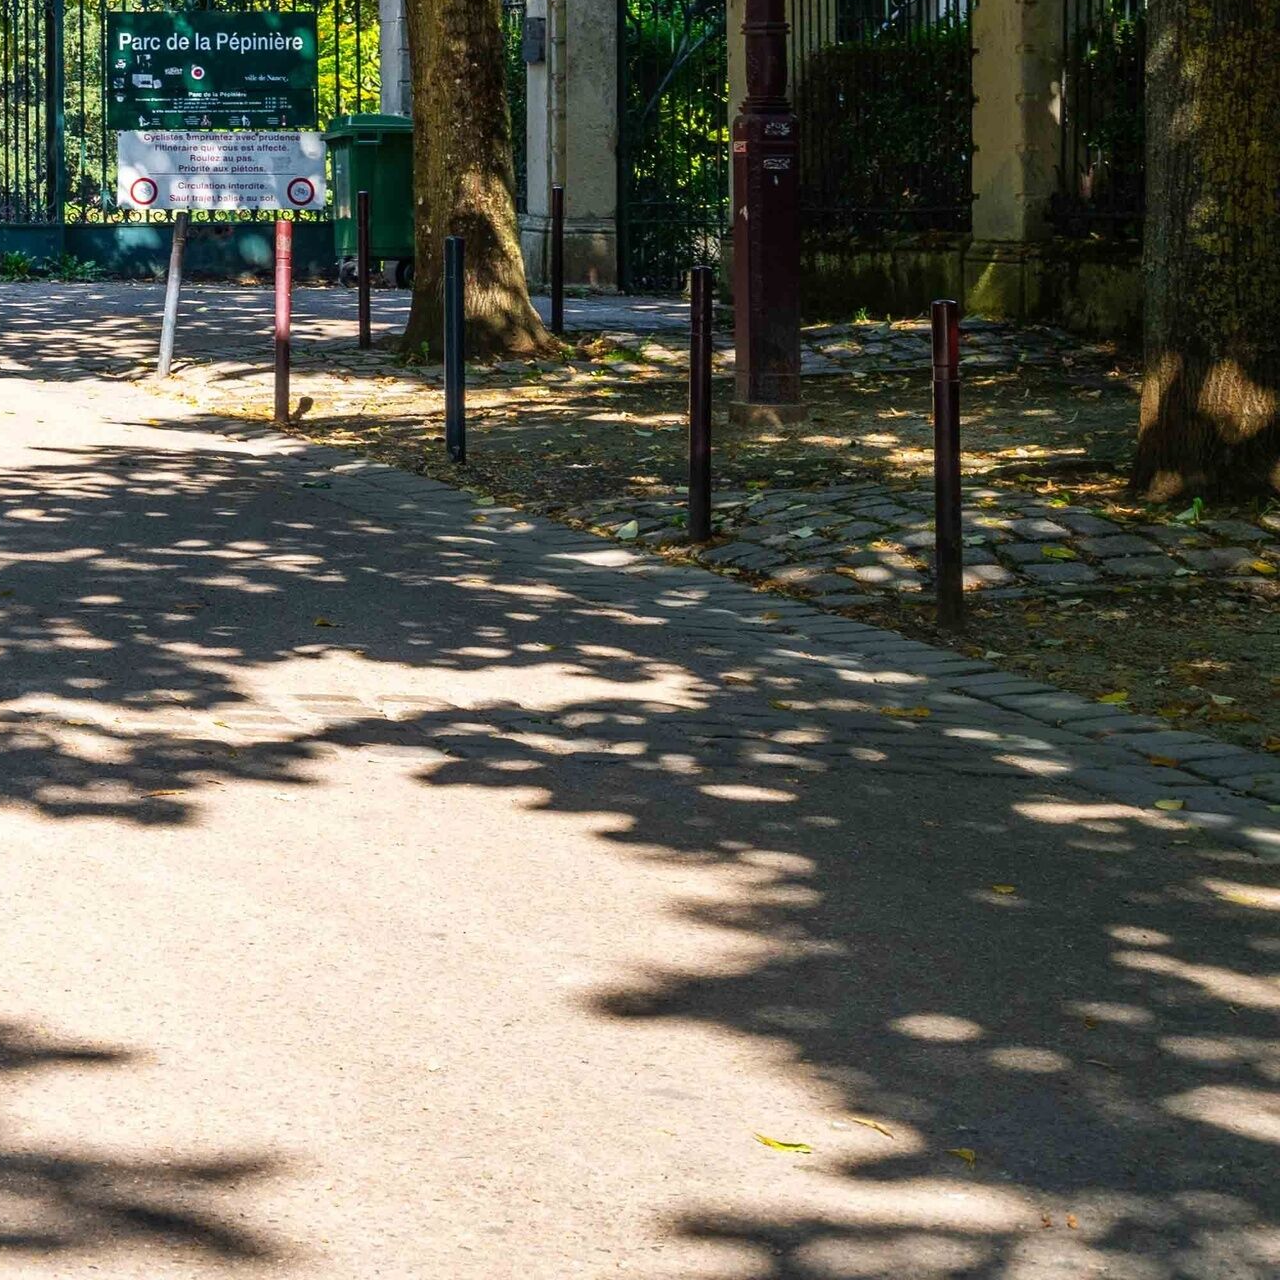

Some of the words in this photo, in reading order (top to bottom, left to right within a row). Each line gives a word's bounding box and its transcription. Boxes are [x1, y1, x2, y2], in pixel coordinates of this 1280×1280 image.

[118, 32, 161, 51] Parc
[166, 32, 190, 51] de
[195, 32, 211, 51] la
[216, 31, 304, 55] Pépinière
[143, 133, 184, 142] Cyclistes
[186, 133, 233, 142] empruntez
[258, 133, 301, 142] prudence
[189, 154, 220, 162] Roulez
[177, 181, 226, 190] Circulation
[169, 194, 190, 202] Sauf
